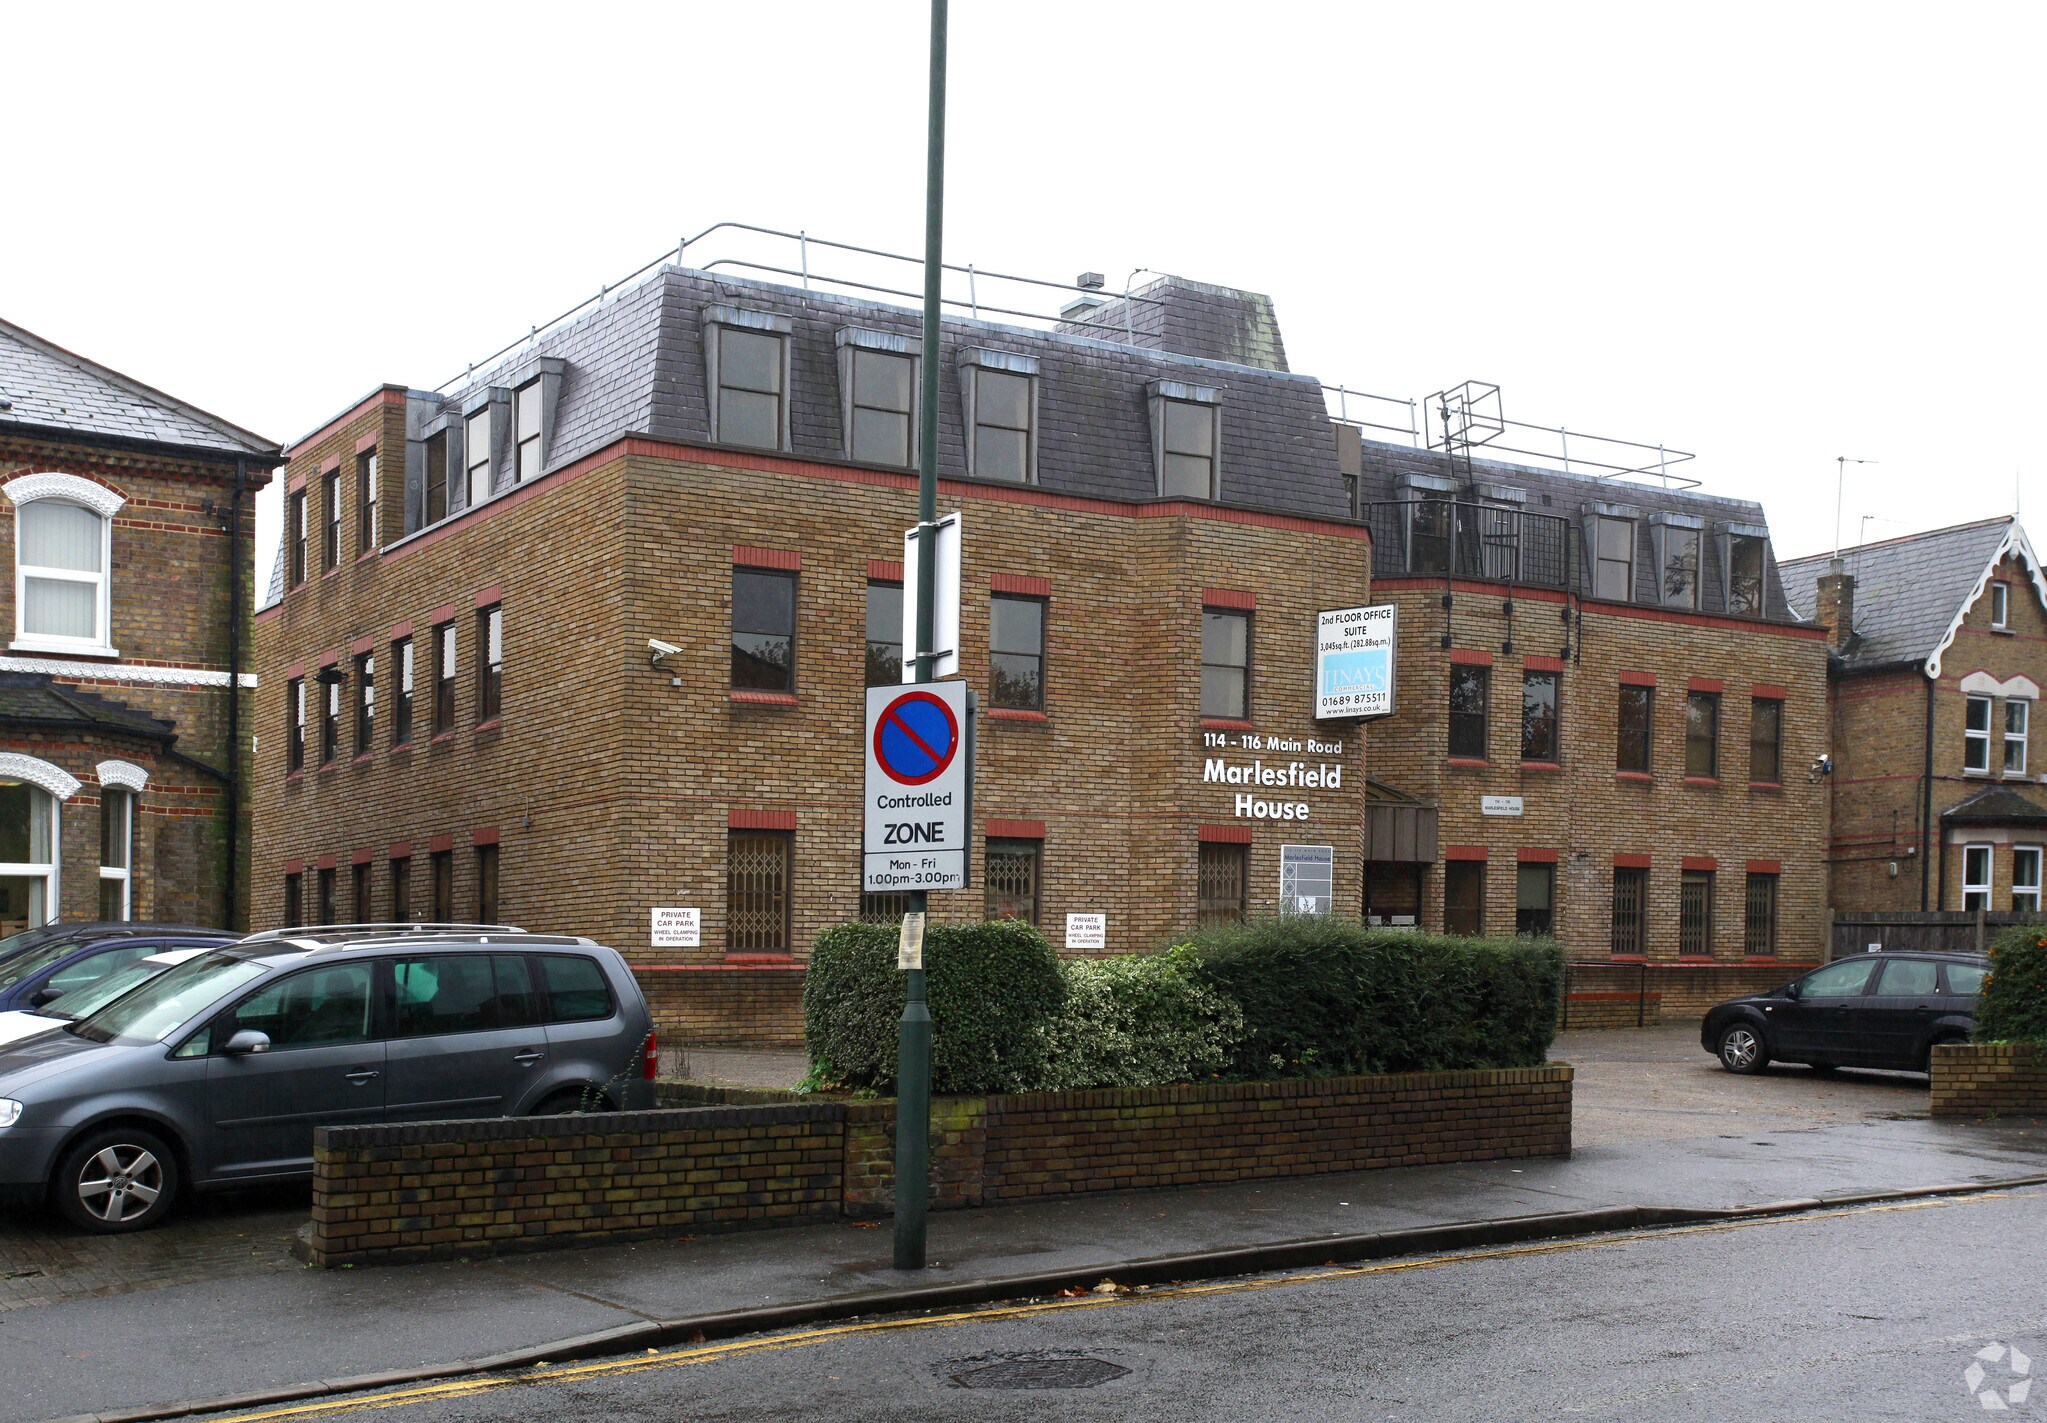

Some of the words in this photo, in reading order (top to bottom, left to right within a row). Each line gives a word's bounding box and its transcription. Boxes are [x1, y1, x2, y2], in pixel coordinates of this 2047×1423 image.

[1321, 615, 1334, 625] 2nd
[1335, 612, 1361, 623] FLOOR
[1363, 609, 1391, 620] OFFICE
[1344, 625, 1367, 637] SUITE
[1324, 665, 1385, 694] LINAYS
[1334, 684, 1374, 692] COMMERCIAL
[1322, 695, 1351, 706] 01689
[1354, 692, 1386, 704] 875511
[1326, 704, 1381, 714] www.linays.co.uk
[1203, 732, 1226, 747] 114
[1241, 735, 1262, 749] 116
[1266, 737, 1302, 751] Main
[1307, 739, 1342, 754] Road
[1203, 758, 1342, 788] Marlesfield
[877, 792, 952, 809] Controlled
[1235, 794, 1310, 820] House
[884, 821, 945, 845] ZONE
[889, 859, 911, 870] Mon
[921, 858, 936, 869] Fri
